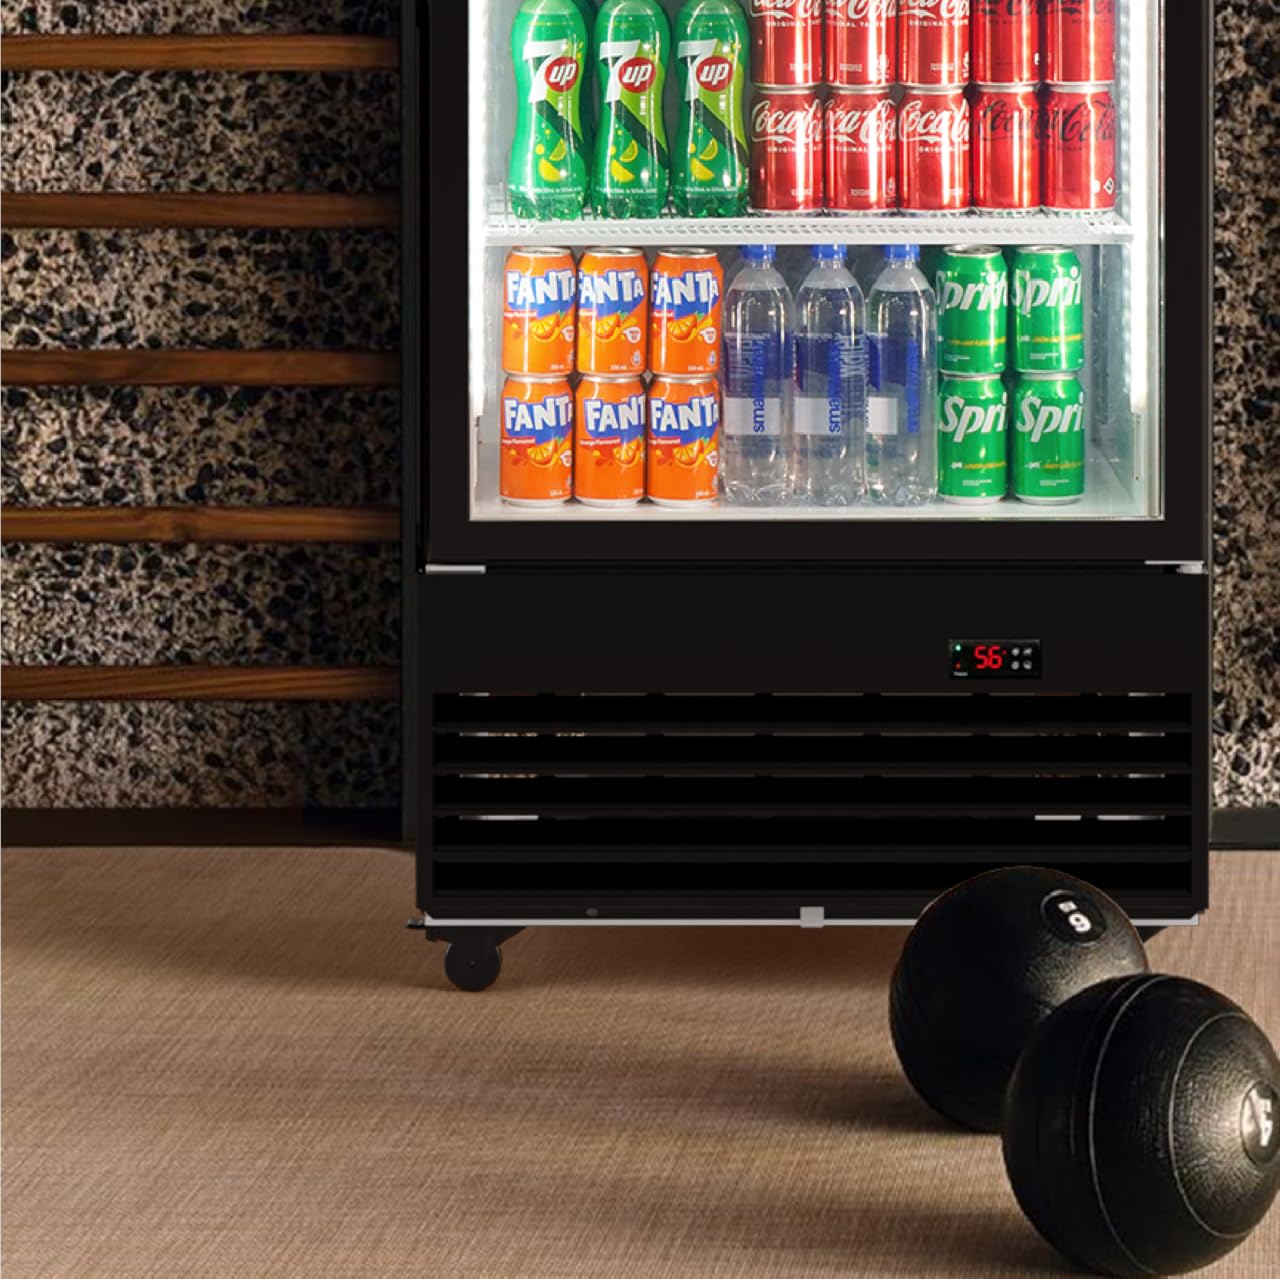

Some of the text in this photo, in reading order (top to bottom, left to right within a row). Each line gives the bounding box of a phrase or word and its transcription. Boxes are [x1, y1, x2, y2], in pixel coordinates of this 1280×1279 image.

[584, 394, 646, 432] FANT
[938, 391, 1007, 443] Spri
[1015, 391, 1085, 443] Spri
[974, 644, 1003, 670] 56
